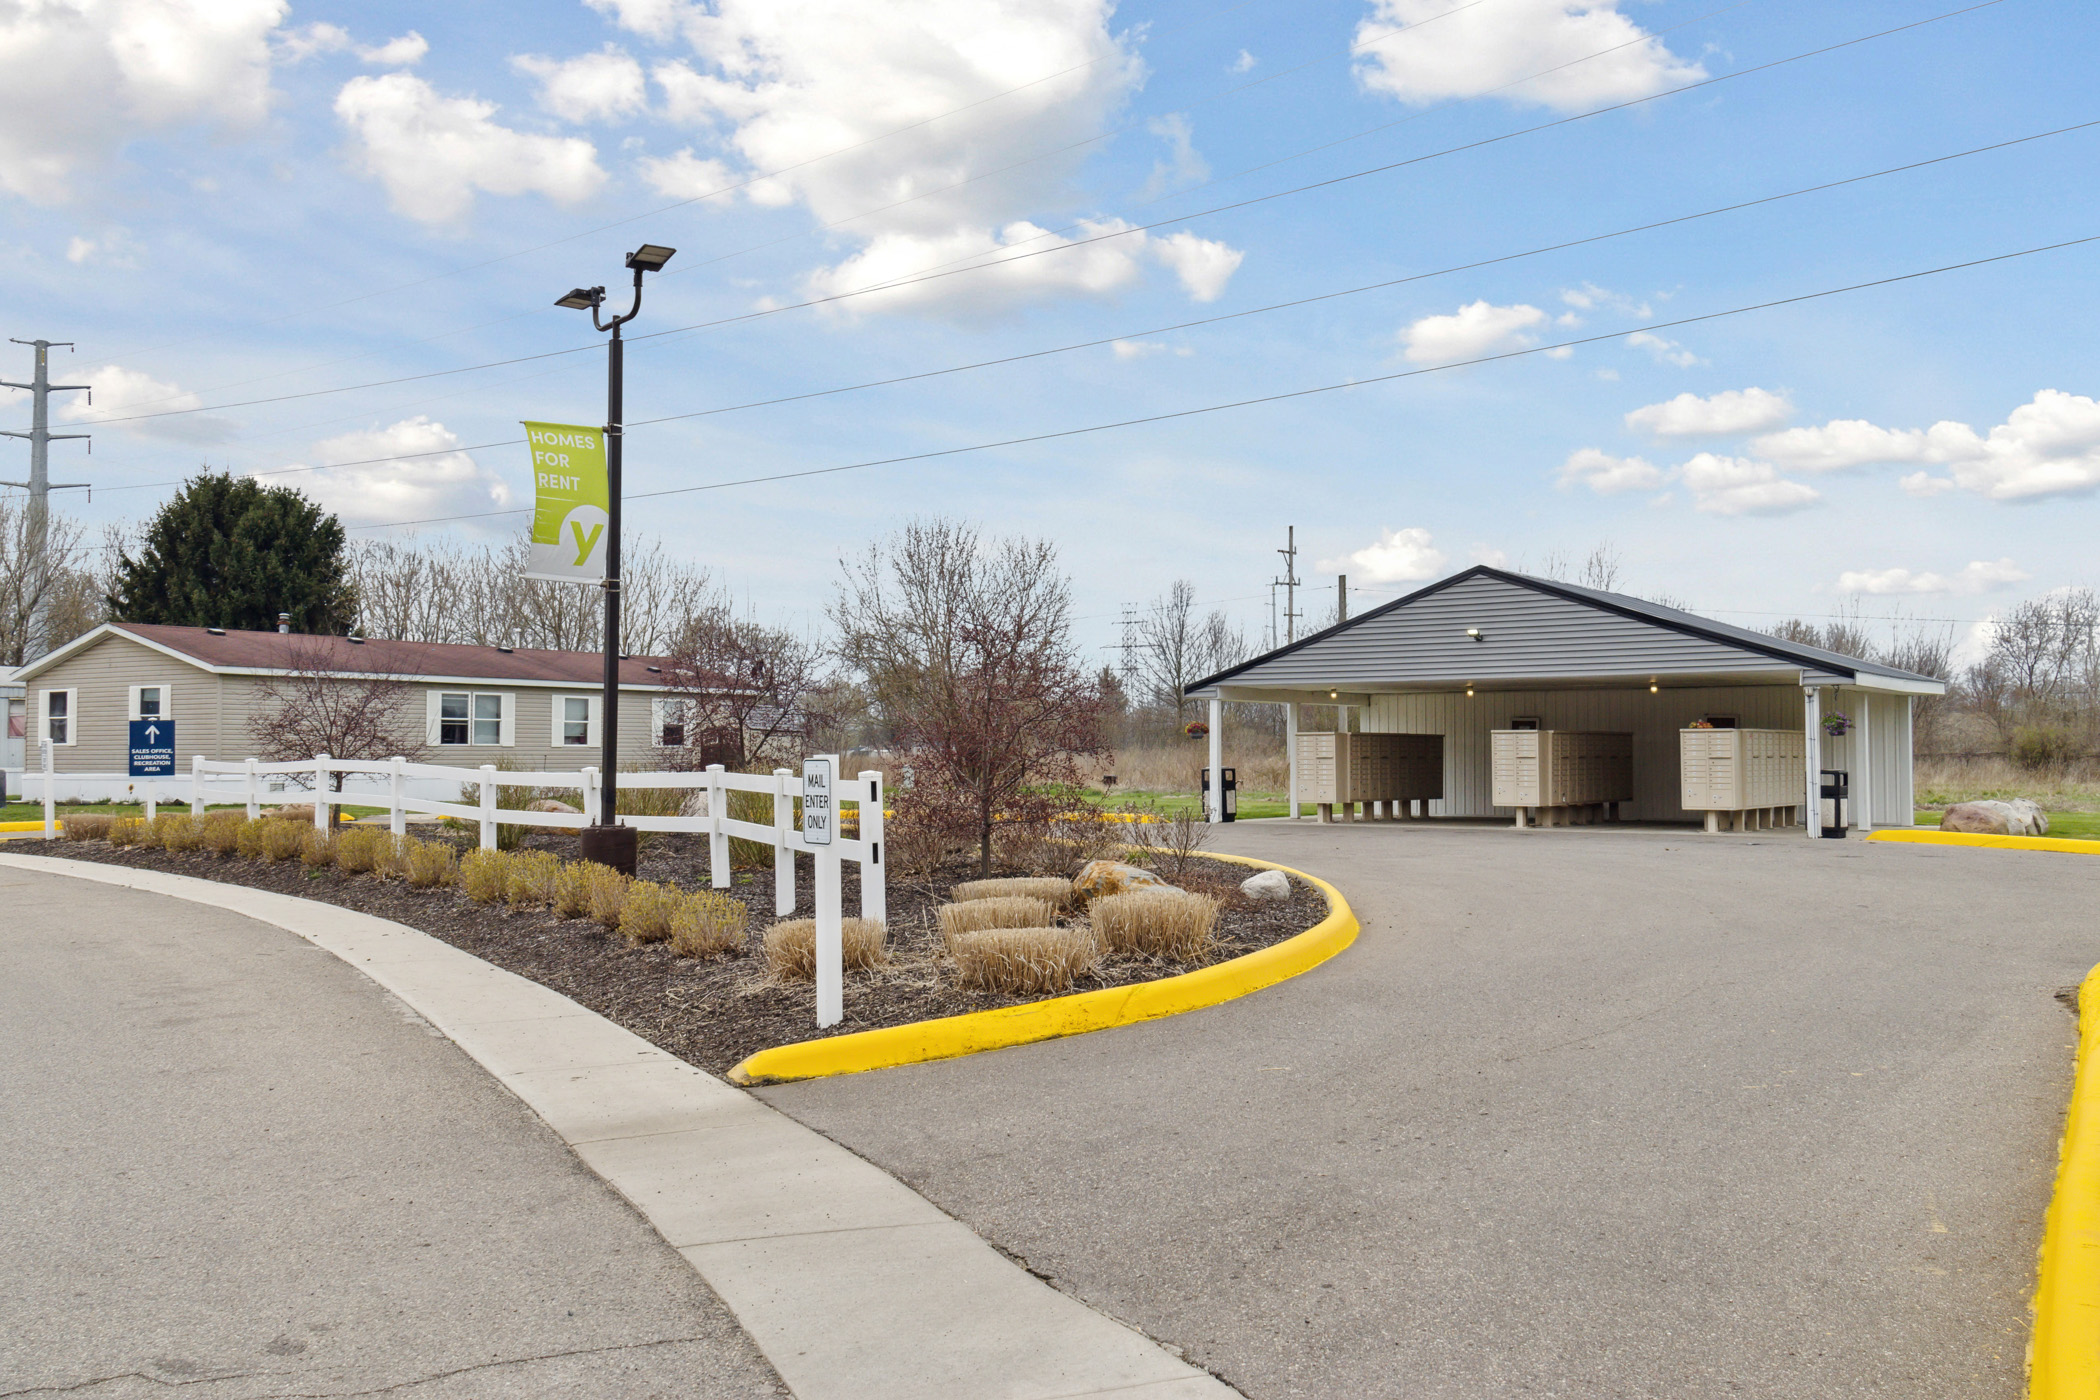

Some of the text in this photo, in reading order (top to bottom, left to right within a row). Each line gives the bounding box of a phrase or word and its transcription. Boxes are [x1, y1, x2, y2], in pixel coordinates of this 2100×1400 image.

[531, 431, 595, 450] HOMES
[535, 451, 570, 468] FOR
[538, 473, 580, 491] RENT
[807, 774, 826, 788] MAIL
[805, 794, 829, 809] ENTER
[807, 814, 827, 830] ONLY
